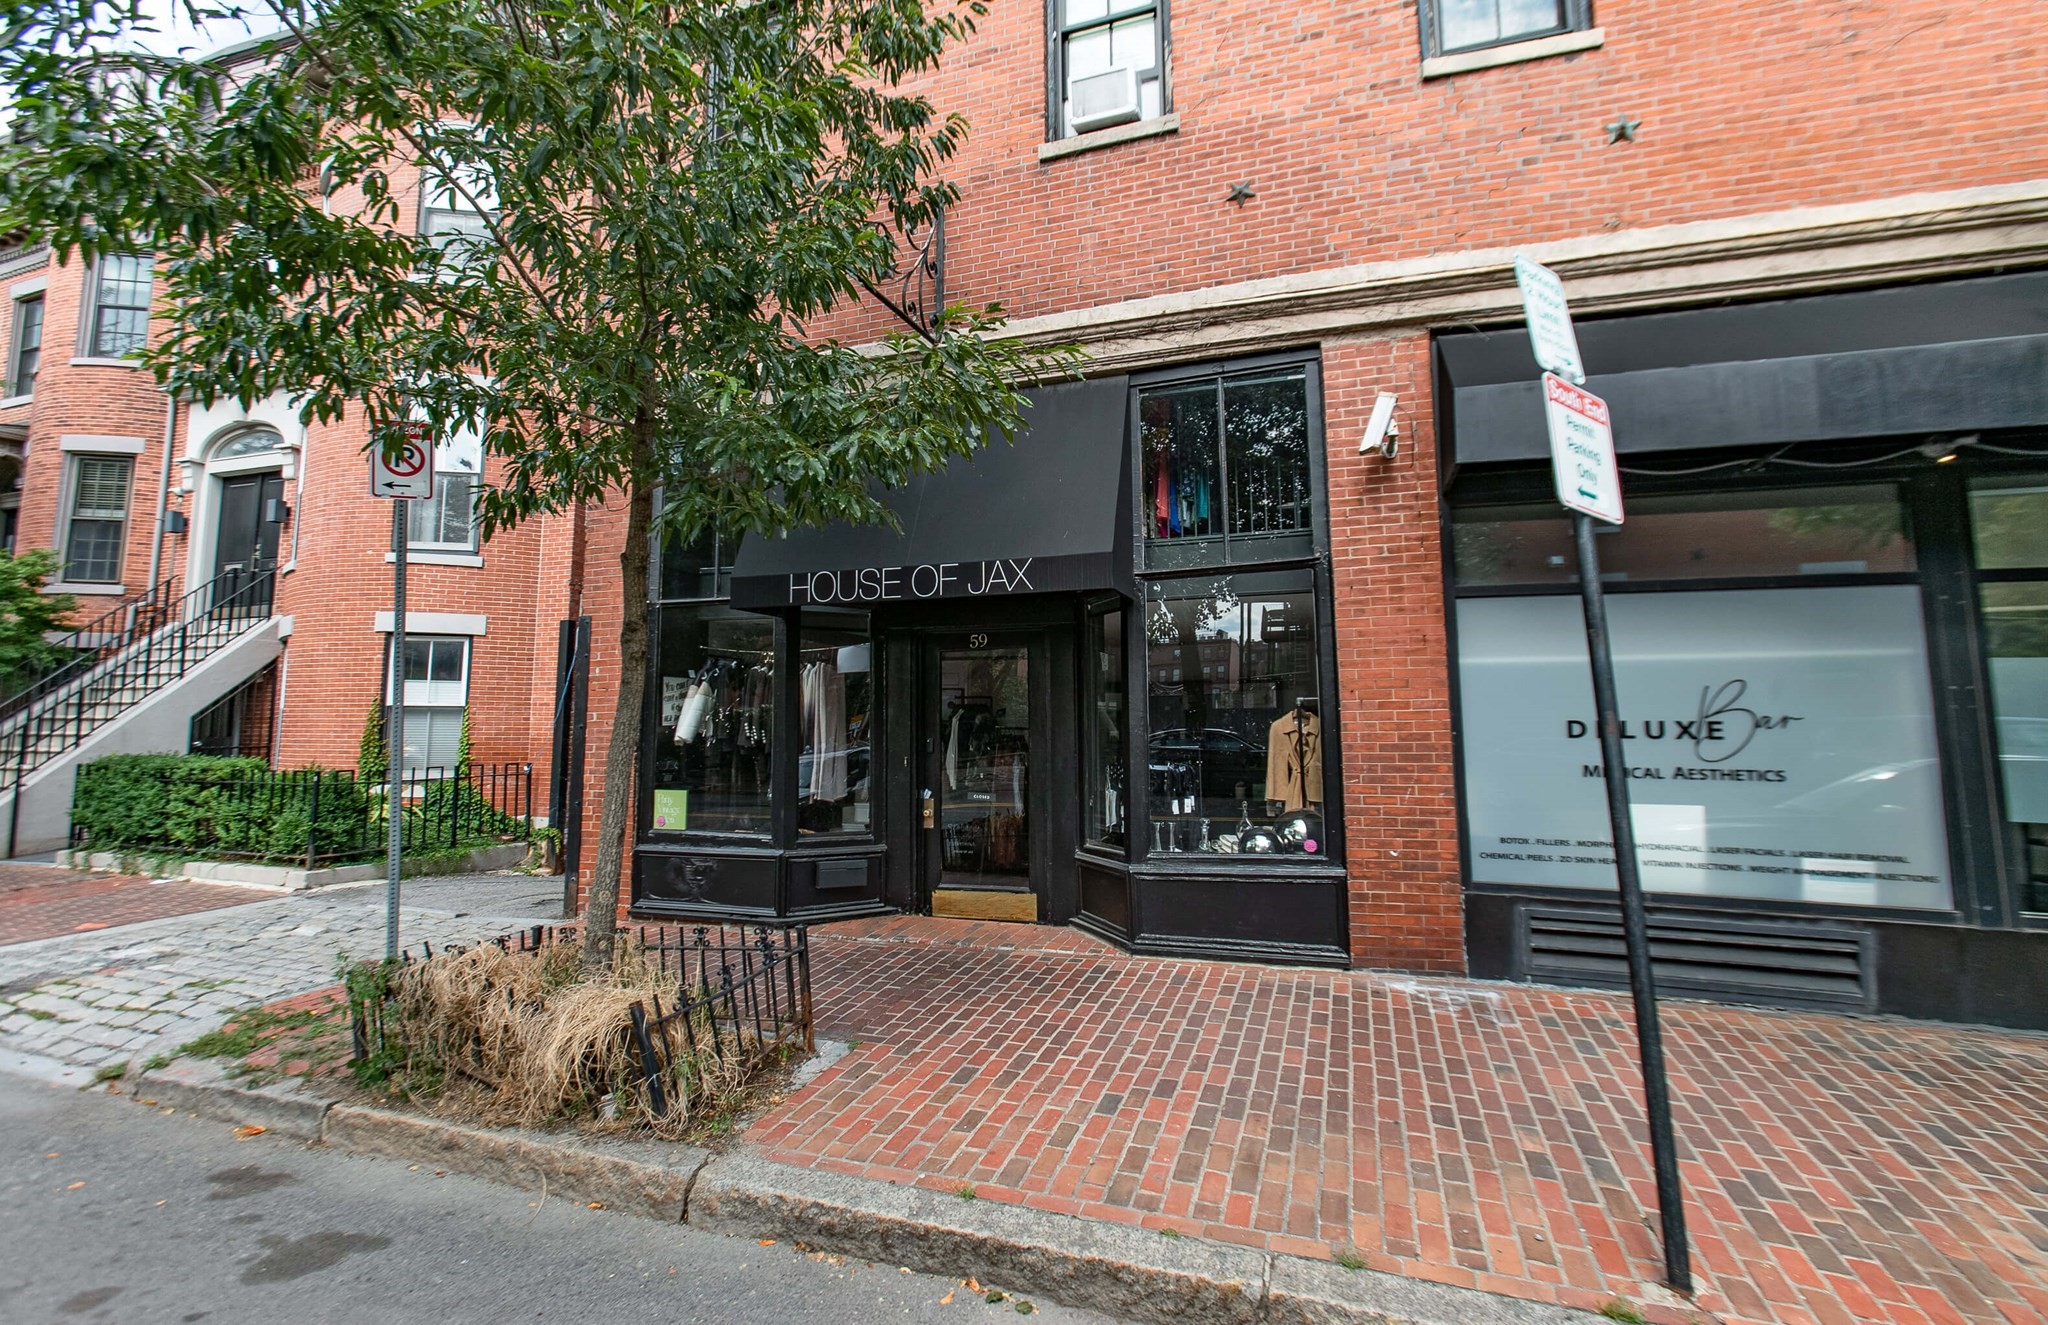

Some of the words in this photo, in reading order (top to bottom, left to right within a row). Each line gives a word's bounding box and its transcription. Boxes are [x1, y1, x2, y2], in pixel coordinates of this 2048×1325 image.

[1550, 379, 1582, 412] South
[1583, 396, 1606, 421] End
[1566, 414, 1596, 438] Permit
[1567, 437, 1602, 466] Parking
[1577, 463, 1598, 486] Only
[789, 566, 902, 604] HOUSE
[911, 562, 959, 598] OF
[967, 557, 1034, 595] JAX
[969, 633, 988, 649] 59
[1566, 719, 1726, 740] DLUXE
[1693, 679, 1804, 763] Bar
[1582, 764, 1666, 780] MICAL
[1672, 766, 1787, 782] AESTHETICS
[1499, 837, 1530, 845] BOTOX
[1536, 838, 1571, 847] FILLERS
[1479, 852, 1525, 861] CHEMICAL
[1527, 854, 1554, 862] PEELS
[1574, 856, 1596, 865] SKIN
